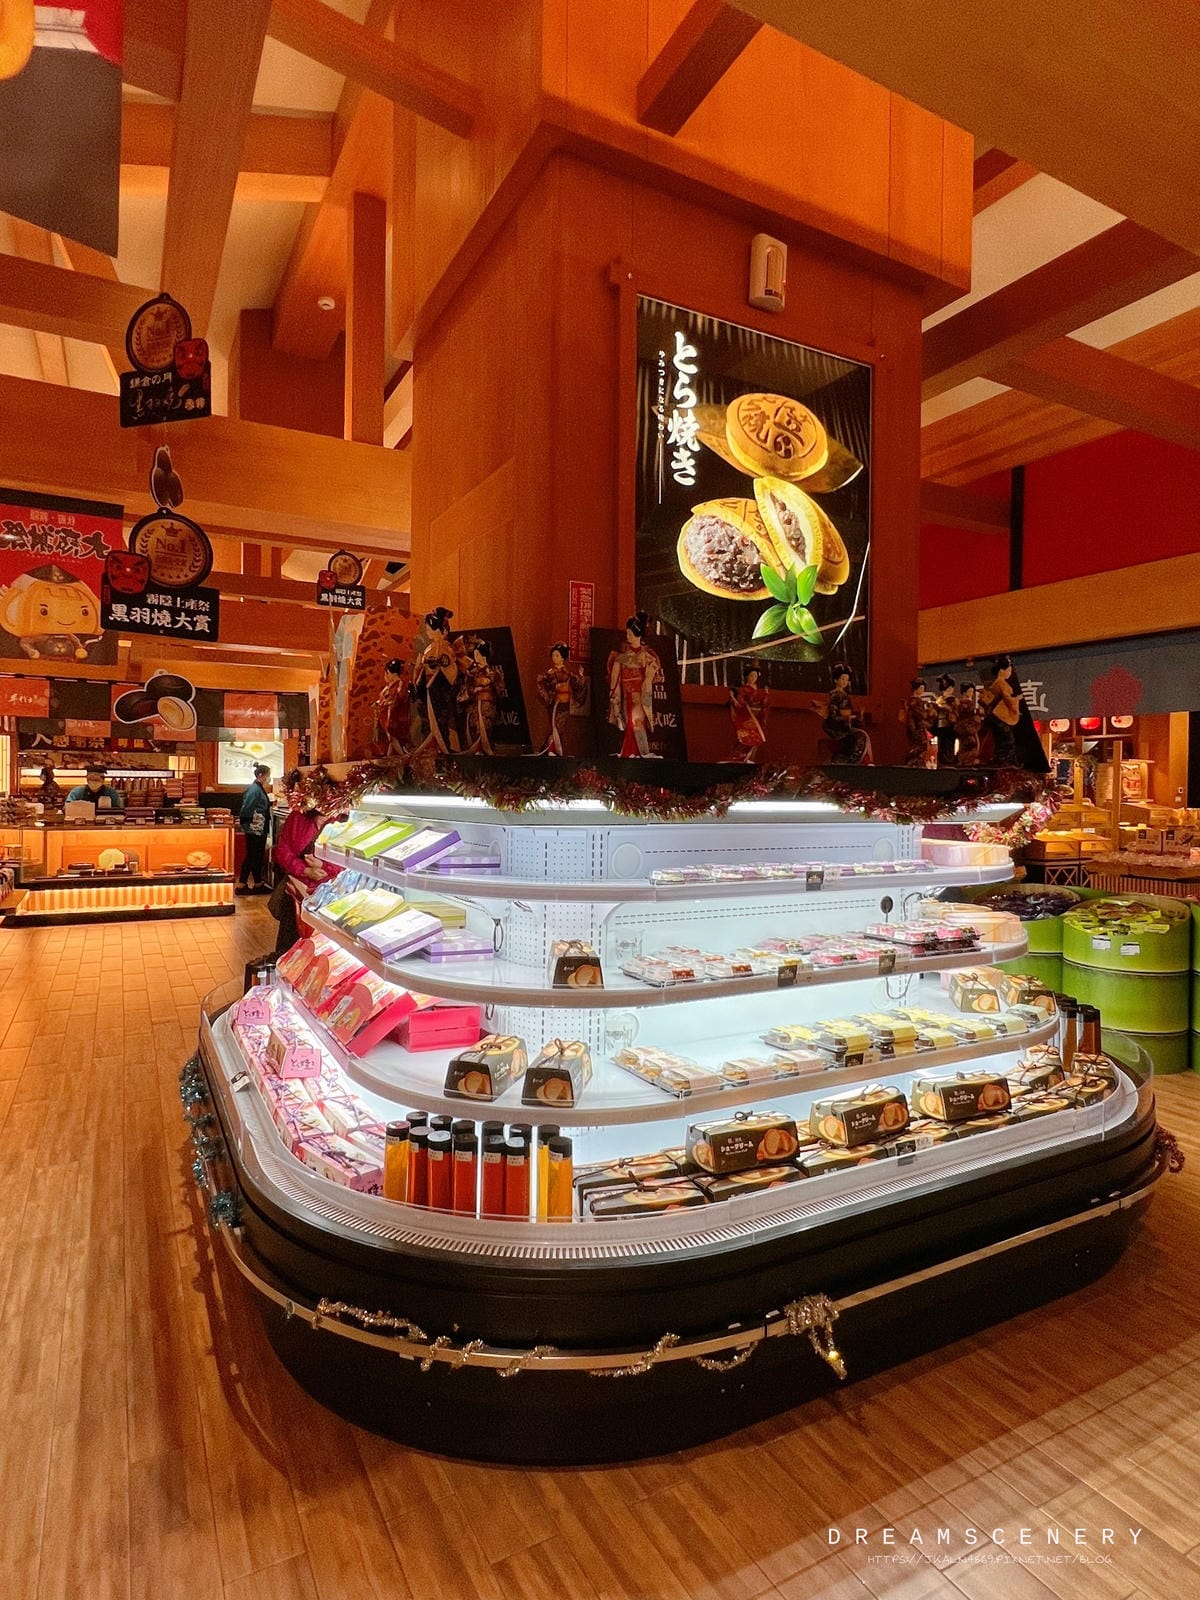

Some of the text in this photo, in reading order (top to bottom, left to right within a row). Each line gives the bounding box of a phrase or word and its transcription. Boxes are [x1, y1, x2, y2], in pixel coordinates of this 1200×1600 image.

[666, 331, 701, 486] とら焼き
[155, 537, 187, 553] No.1
[108, 603, 212, 633] 黑羽燒大賞
